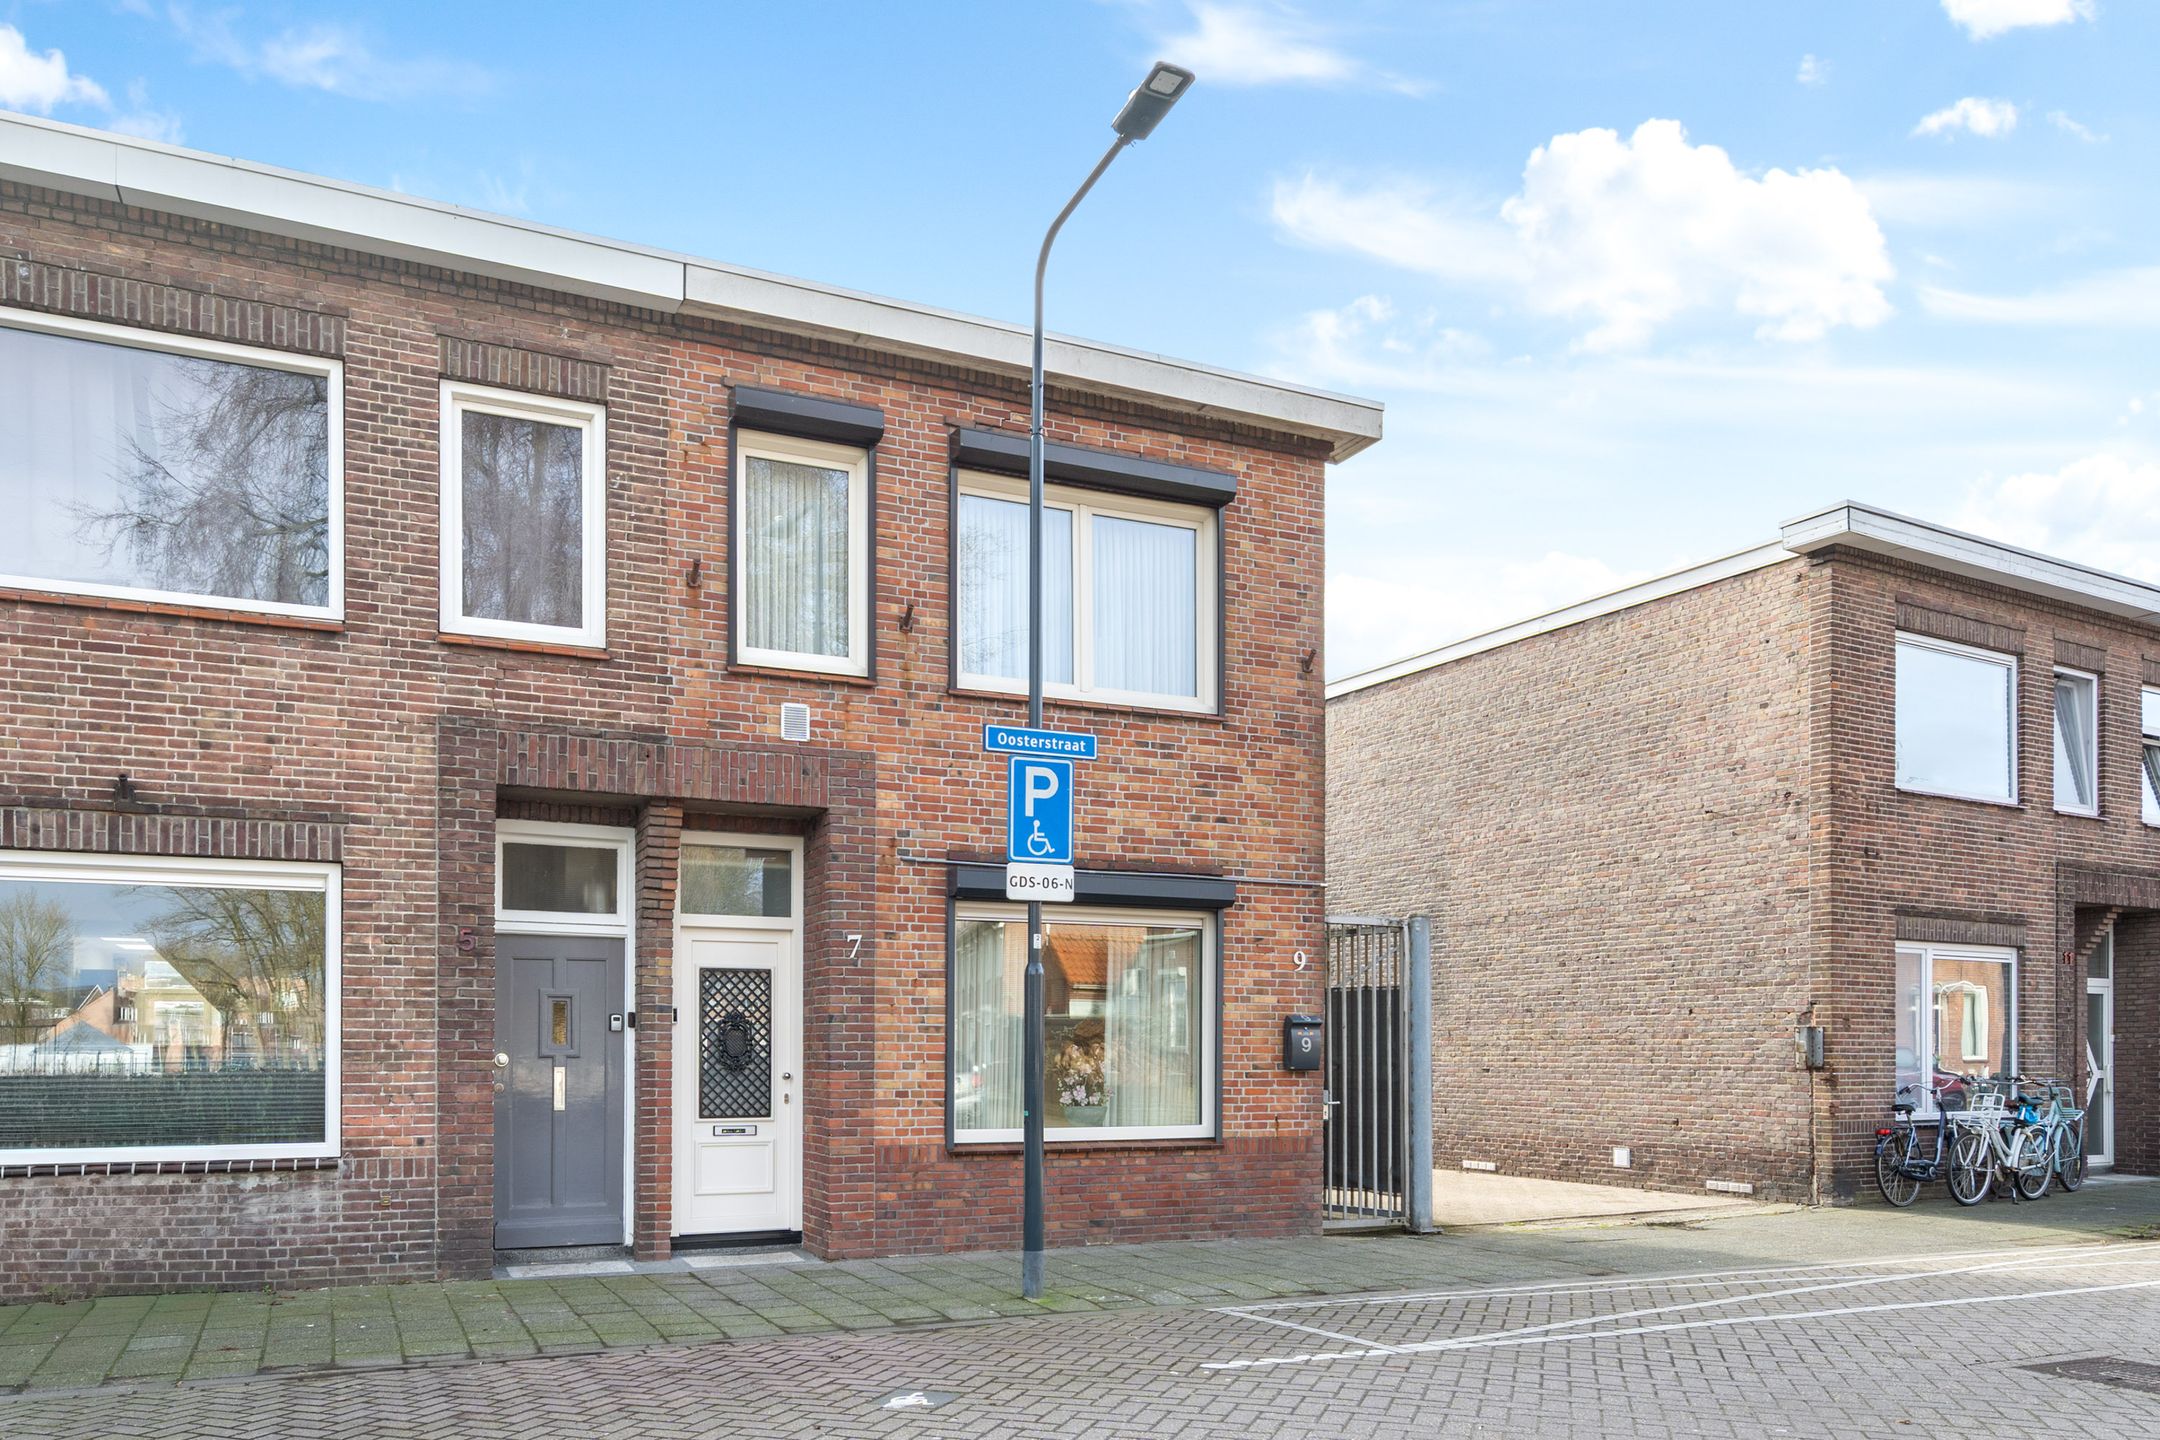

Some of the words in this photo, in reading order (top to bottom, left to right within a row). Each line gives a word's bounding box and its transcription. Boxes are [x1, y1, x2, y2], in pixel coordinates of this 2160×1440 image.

[997, 732, 1086, 752] Oosterstraat
[1025, 766, 1059, 817] P
[1010, 875, 1073, 890] GDS-06-N
[461, 927, 475, 951] 5
[847, 934, 862, 958] 7
[1293, 951, 1306, 971] 9
[1301, 1037, 1311, 1053] 9
